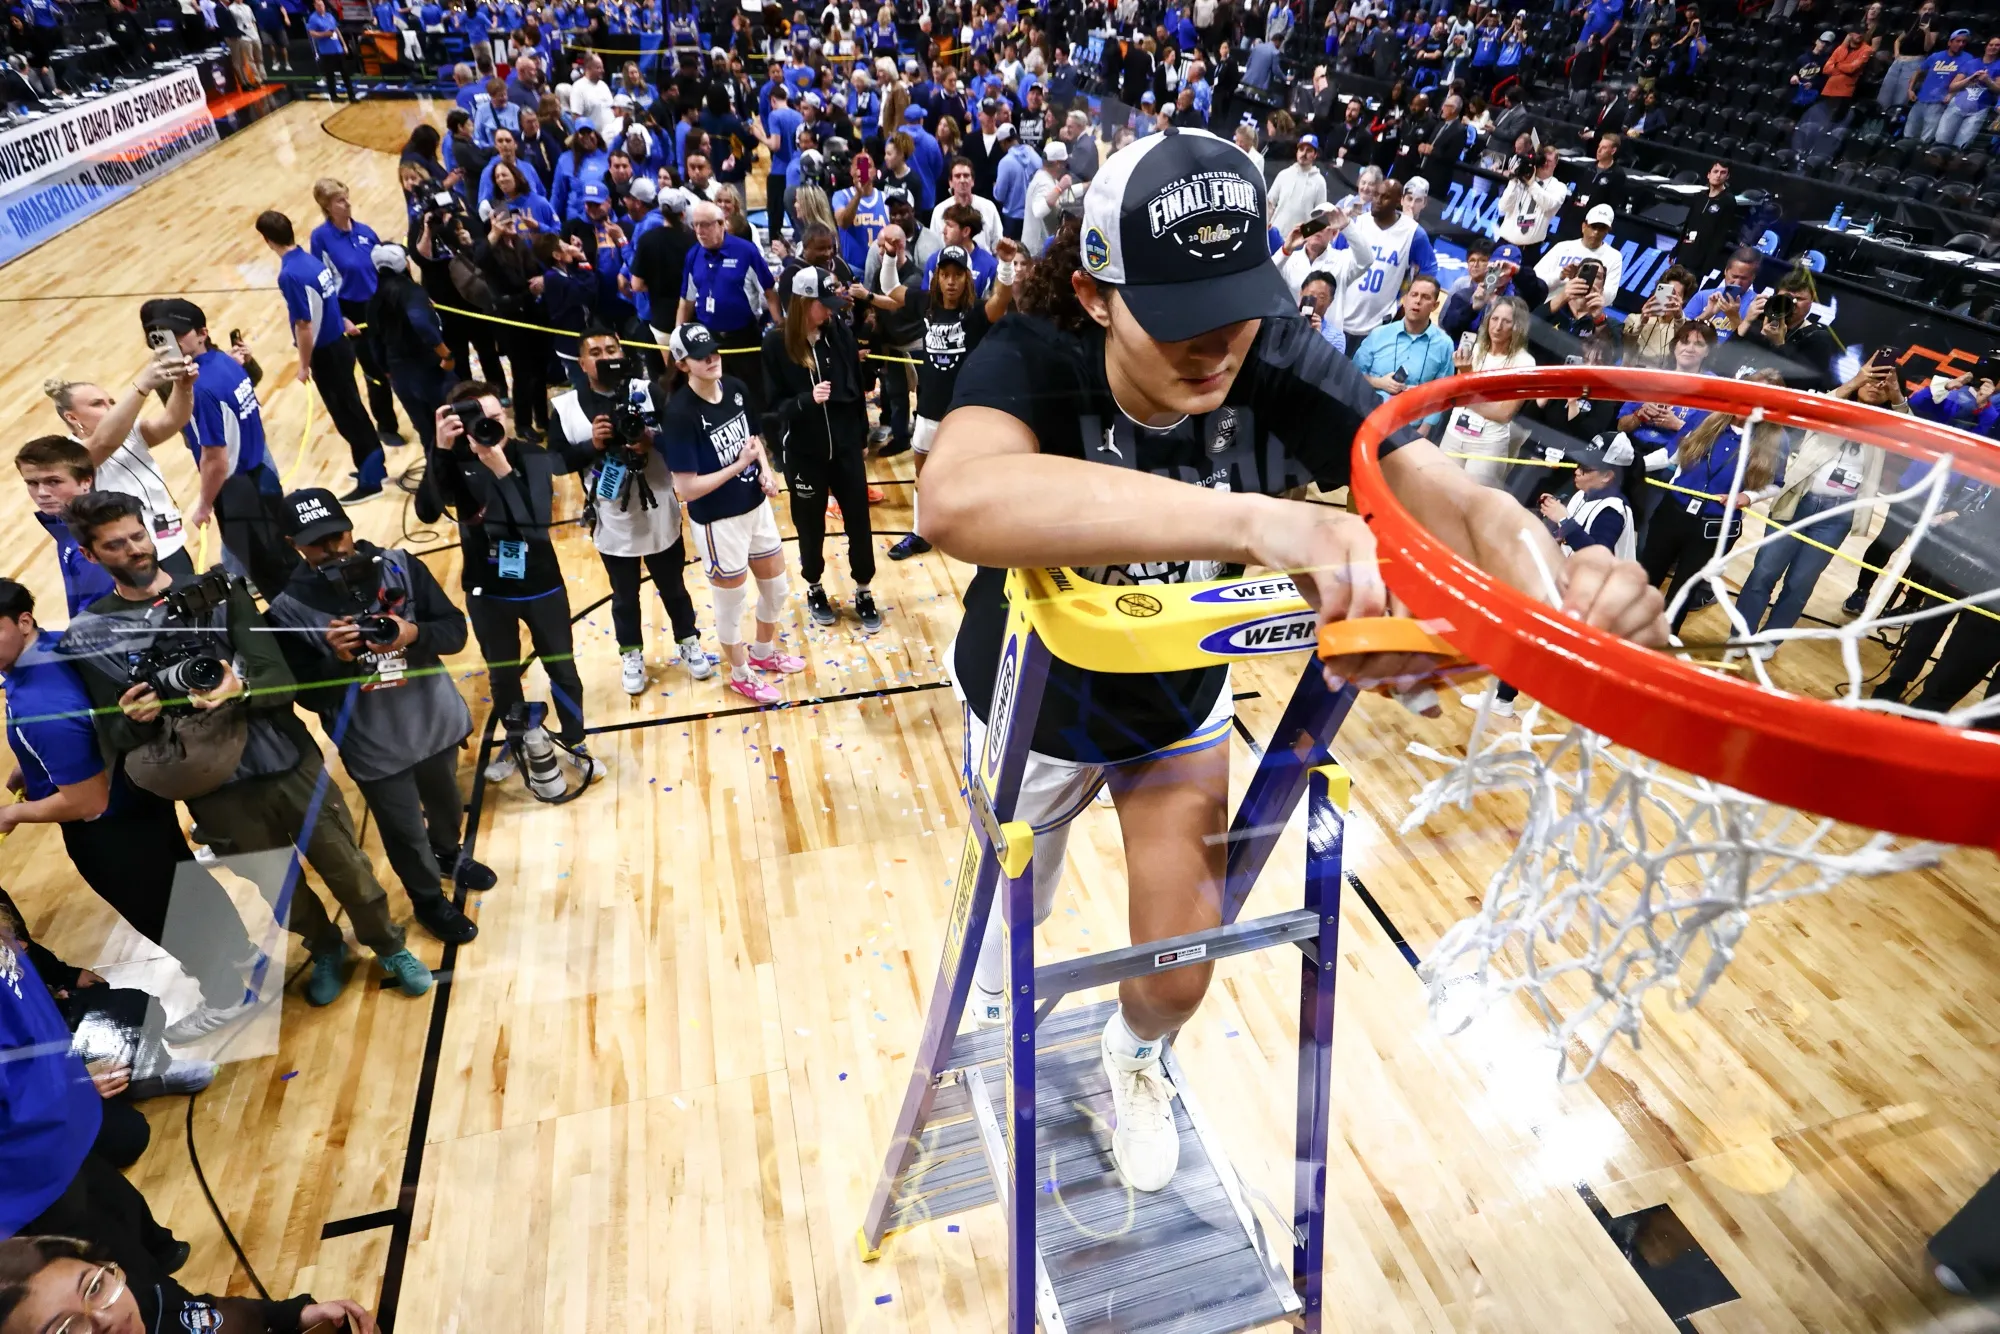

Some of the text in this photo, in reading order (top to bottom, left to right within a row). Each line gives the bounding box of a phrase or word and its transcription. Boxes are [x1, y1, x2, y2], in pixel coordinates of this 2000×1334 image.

[0, 77, 201, 185] NIVERSITY OF IDAHO AND SPOKANE ARENA
[1161, 171, 1241, 194] NCAA BASKETBALL
[854, 213, 886, 227] UCLA
[1149, 179, 1259, 238] FINAL FOUR
[1188, 234, 1199, 242] 20
[1559, 256, 1583, 267] UC
[1358, 267, 1385, 293] 30
[709, 420, 745, 453] READY
[1194, 468, 1228, 487] PIONS
[295, 497, 322, 514] FILM
[299, 507, 332, 524] CREW.
[1045, 567, 1074, 592] ETBALL
[1233, 581, 1296, 599] WER
[1245, 620, 1316, 647] WERN
[991, 661, 1013, 753] WERNER
